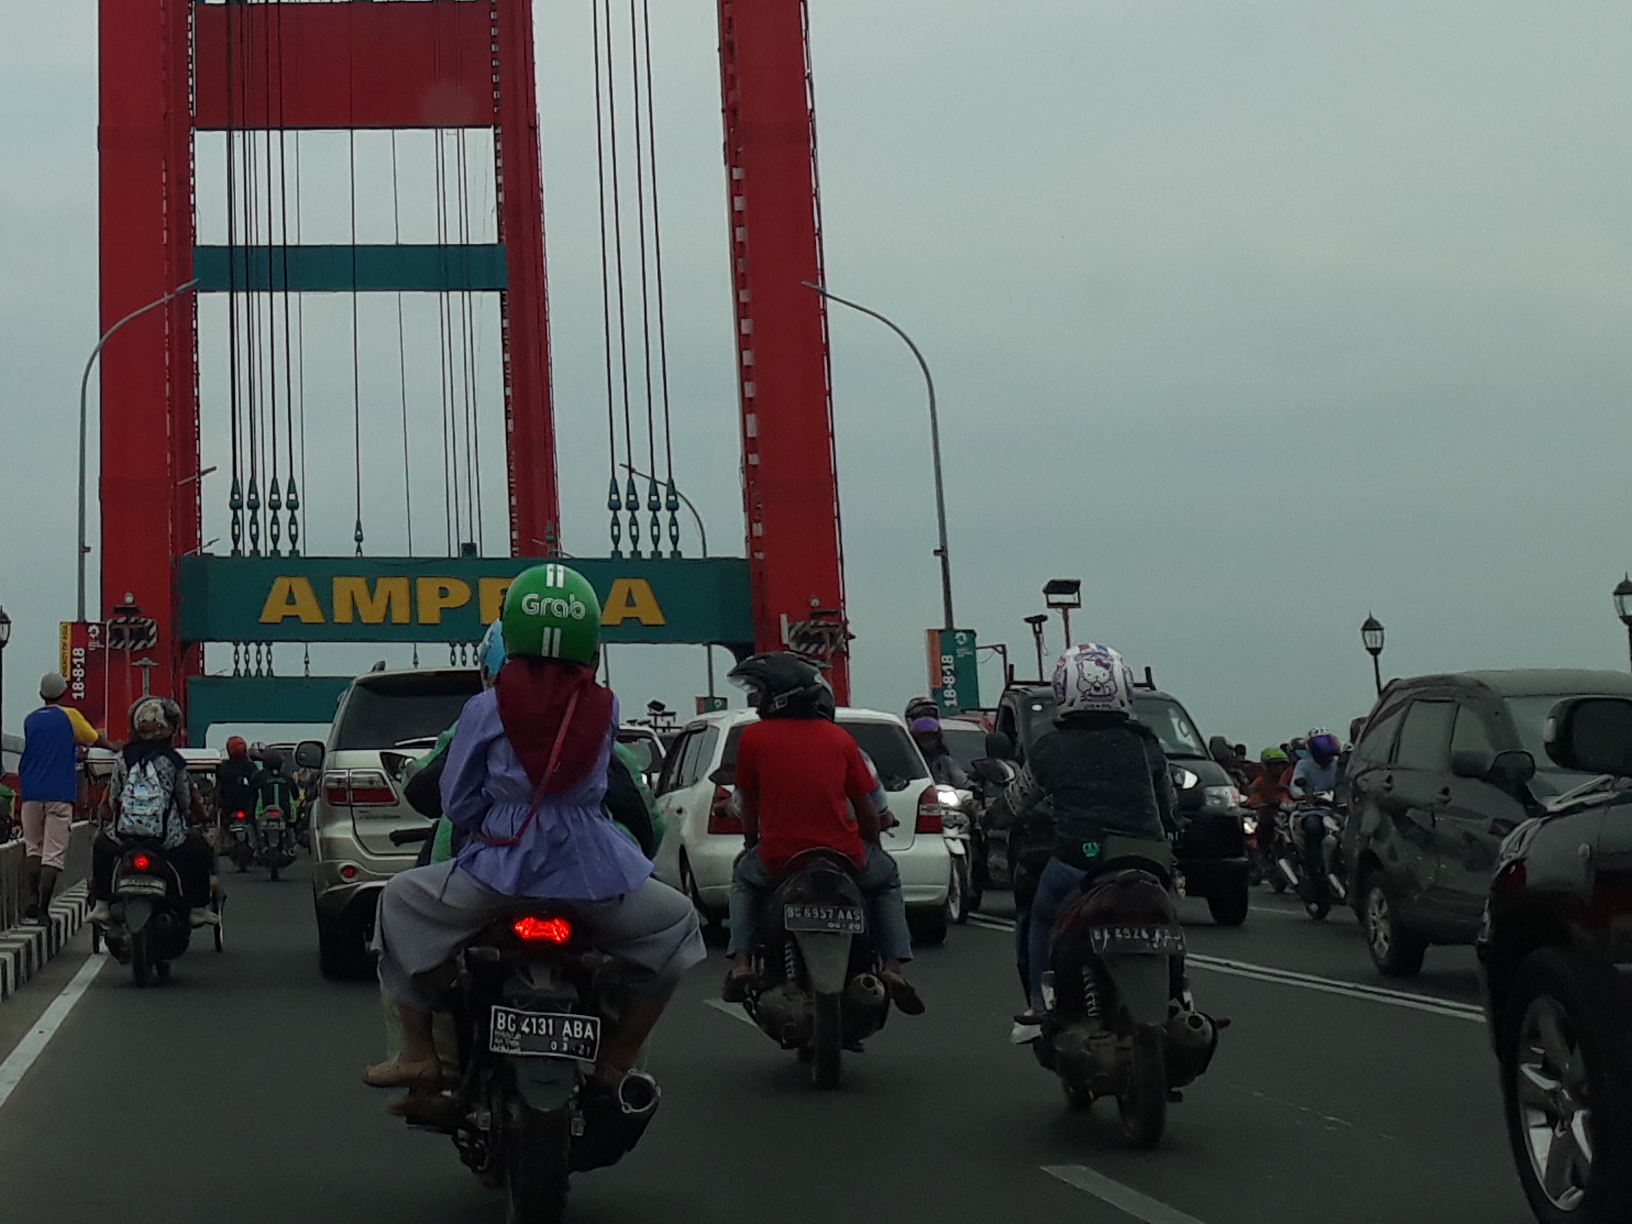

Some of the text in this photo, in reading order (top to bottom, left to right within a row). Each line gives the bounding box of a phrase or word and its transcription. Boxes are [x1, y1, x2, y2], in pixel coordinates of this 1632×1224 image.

[521, 593, 586, 620] Grab
[497, 1011, 595, 1041] BG 4131 ABA
